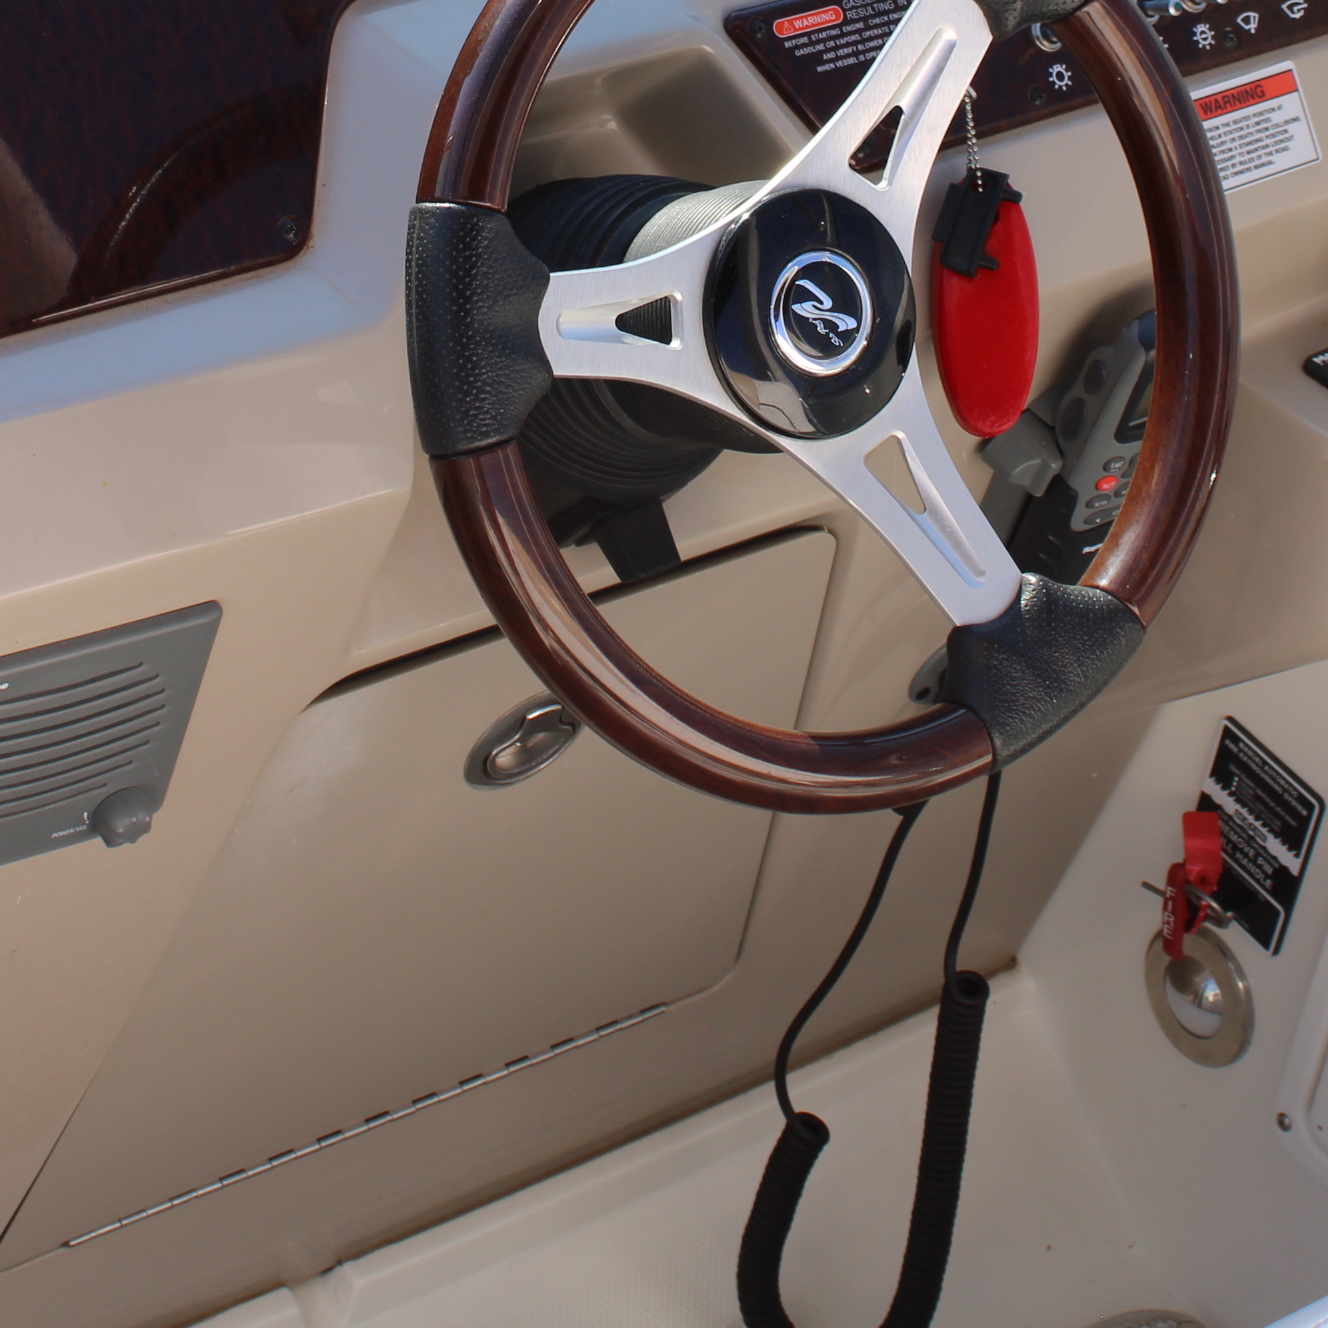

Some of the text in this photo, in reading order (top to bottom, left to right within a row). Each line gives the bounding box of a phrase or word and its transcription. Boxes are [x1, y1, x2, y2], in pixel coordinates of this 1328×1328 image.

[794, 11, 834, 28] WARNING
[847, 0, 893, 19] RESULTING
[784, 37, 808, 47] BEFORE
[811, 28, 839, 40] STARTING
[869, 15, 887, 24] CHECK
[795, 43, 824, 55] GASOLINE
[863, 27, 888, 37] OPERATE
[837, 46, 856, 55] VERIFY
[858, 40, 882, 49] BLOWER
[817, 63, 834, 71] WHEN
[836, 57, 857, 66] VESSEL
[1200, 83, 1265, 115] WARNING
[1232, 115, 1250, 124] SEATED
[1252, 107, 1275, 118] POSITION
[1225, 739, 1238, 754] FIRE
[1283, 791, 1307, 817] SYSTEM
[1238, 741, 1263, 766] MANUAL
[1263, 764, 1298, 798] AUTOMATIC
[1233, 850, 1273, 891] HANDLE
[1256, 856, 1273, 876] PIN
